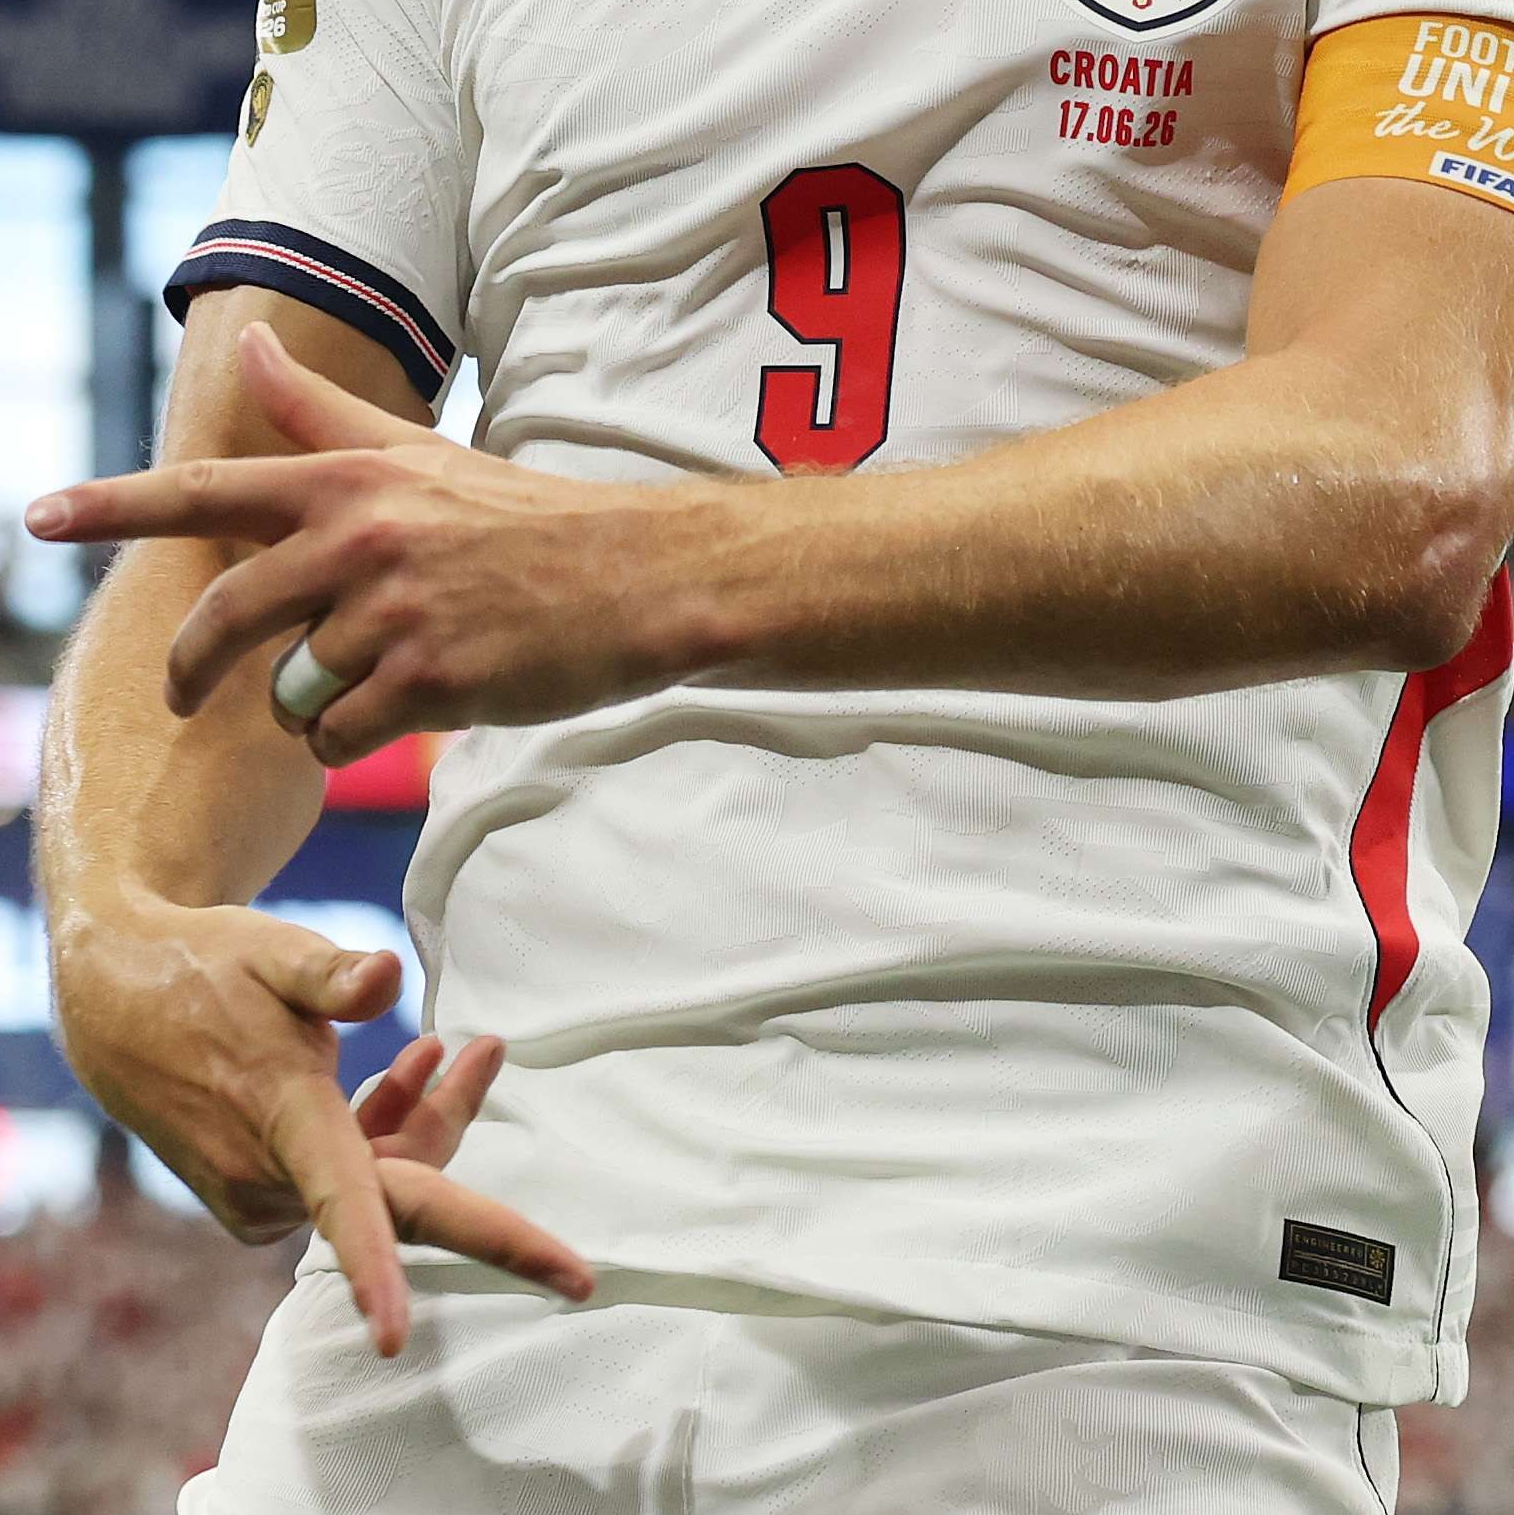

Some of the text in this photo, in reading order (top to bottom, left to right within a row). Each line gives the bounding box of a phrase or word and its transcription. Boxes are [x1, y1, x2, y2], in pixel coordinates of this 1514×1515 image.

[1049, 49, 1194, 98] CROATIA
[1058, 99, 1178, 148] 17.06.26
[1374, 100, 1461, 140] the
[753, 162, 907, 477] 9
